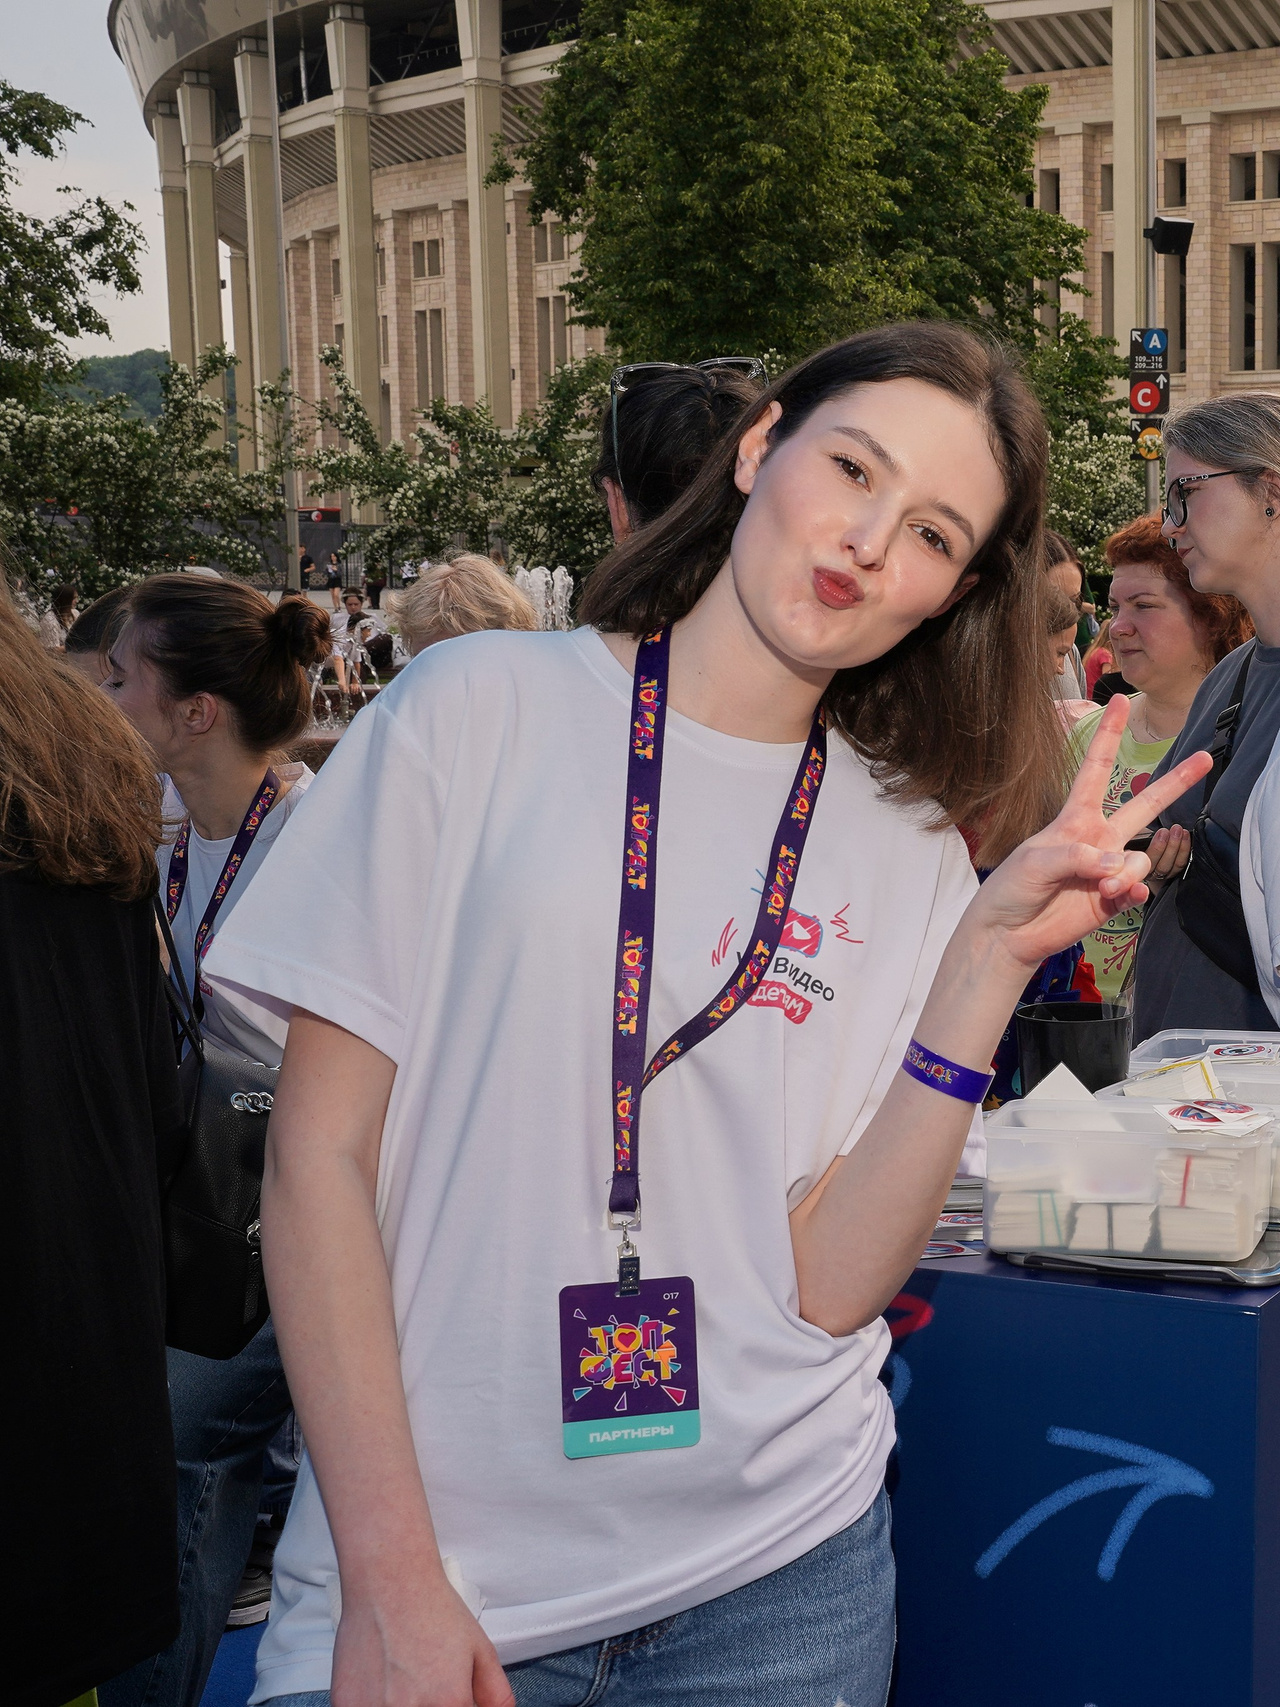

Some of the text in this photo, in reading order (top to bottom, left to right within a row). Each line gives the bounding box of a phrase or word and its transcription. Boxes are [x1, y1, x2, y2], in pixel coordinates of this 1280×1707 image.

[1149, 333, 1161, 349] A
[1137, 388, 1151, 407] C
[773, 957, 835, 1001] Видео
[588, 1425, 675, 1443] ПАРТНЕРЫ
